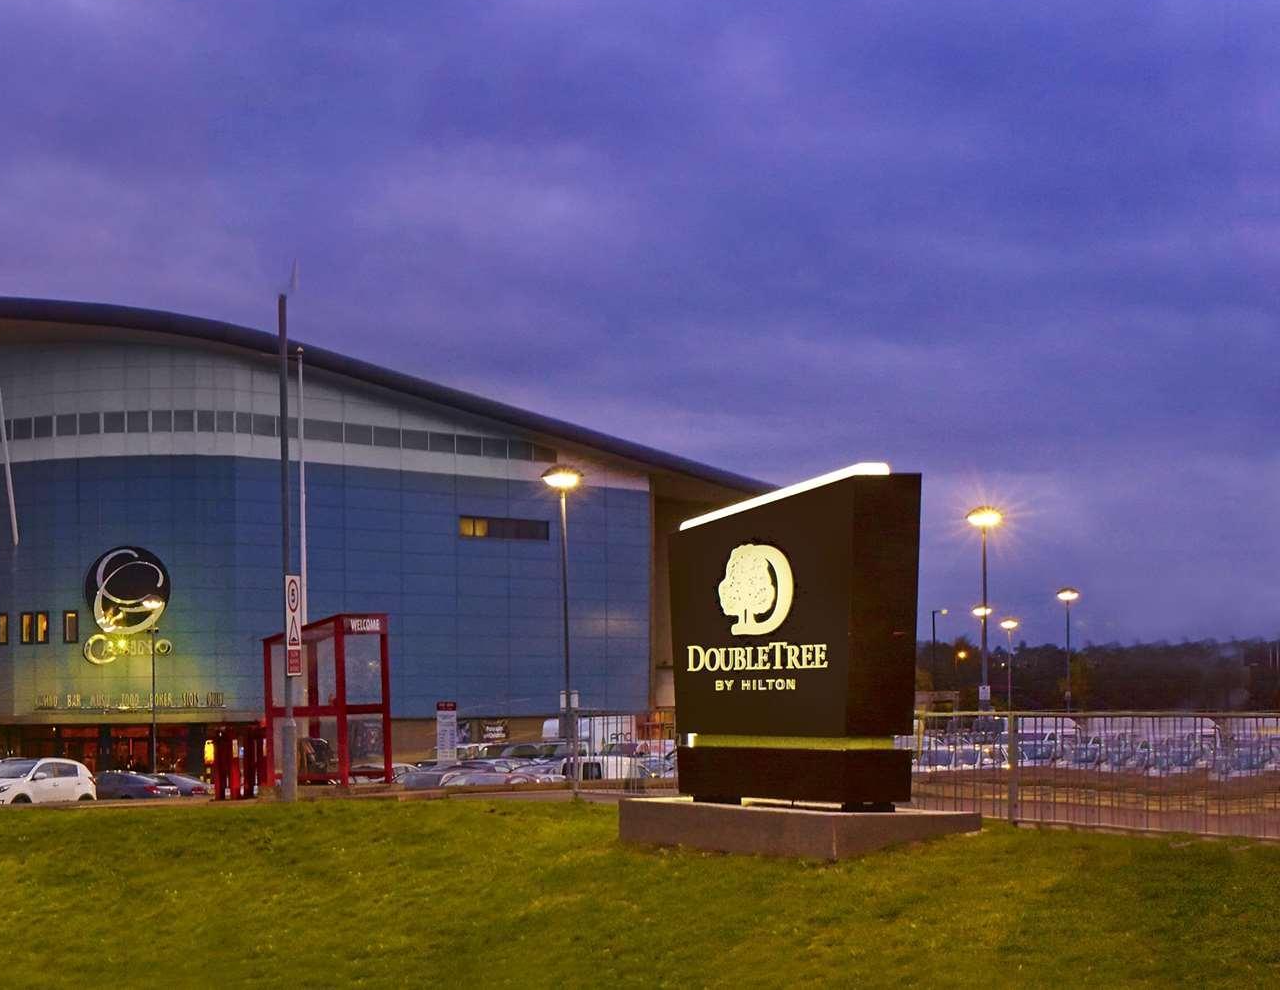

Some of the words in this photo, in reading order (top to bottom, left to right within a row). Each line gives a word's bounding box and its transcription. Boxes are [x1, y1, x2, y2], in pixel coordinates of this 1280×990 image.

[350, 618, 380, 631] WELCOME
[687, 641, 828, 672] DOUBLETREE
[715, 680, 735, 691] BY
[741, 679, 796, 691] HILTON
